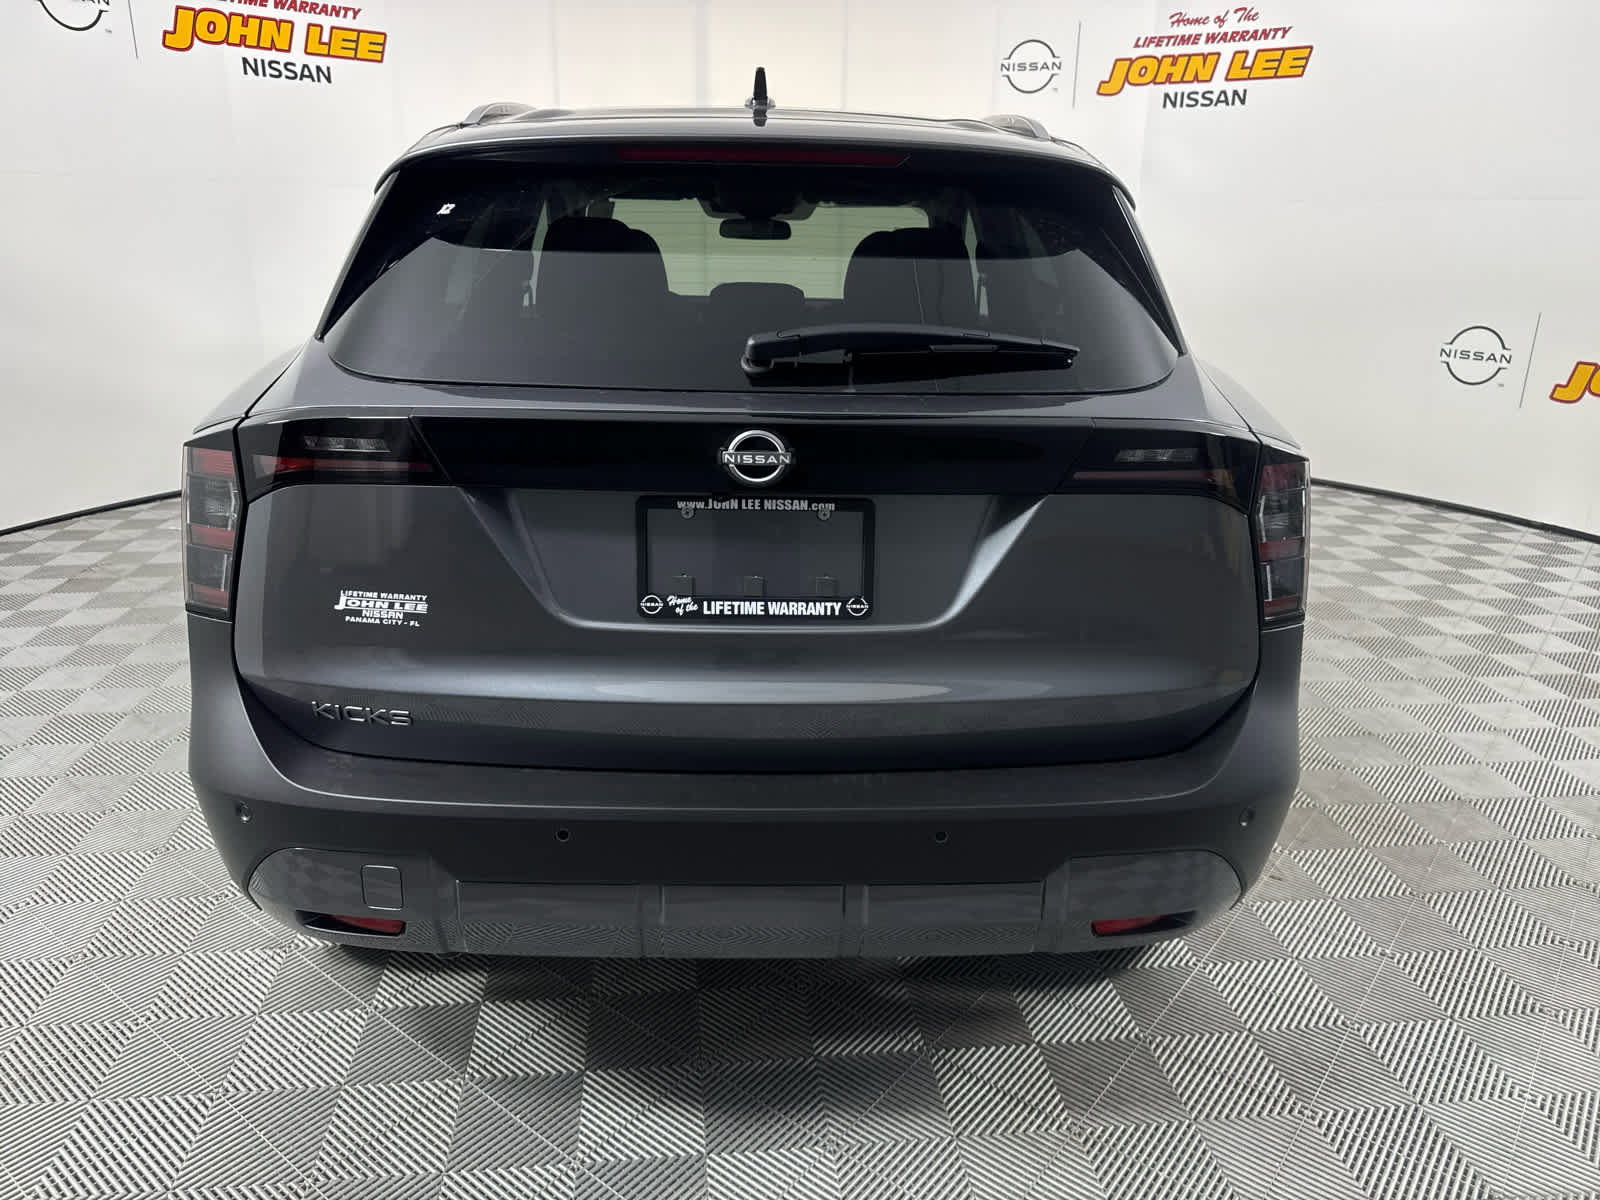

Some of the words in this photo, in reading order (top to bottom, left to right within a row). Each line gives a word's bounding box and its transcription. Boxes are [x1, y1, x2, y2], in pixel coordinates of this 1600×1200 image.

[273, 0, 361, 20] WARRANTY
[1169, 12, 1210, 28] Home
[1213, 10, 1229, 28] of
[1233, 7, 1259, 23] The
[163, 5, 294, 52] JOHN
[304, 24, 387, 62] LEE
[1133, 33, 1202, 48] LIFETIME
[1204, 26, 1293, 44] WARRANTY
[241, 57, 333, 84] NISSAN
[1000, 61, 1062, 72] NISSAN
[1097, 52, 1221, 96] JOHN
[1225, 46, 1313, 81] LEE
[1162, 89, 1247, 109] NISSAN
[1439, 348, 1512, 364] NISSAN
[724, 453, 791, 464] NISSAN
[741, 500, 761, 510] LEE
[341, 590, 378, 599] LIFETIME
[380, 593, 428, 601] WARRANTY
[333, 596, 389, 610] JOHN
[394, 602, 428, 612] LEE
[703, 601, 765, 615] LIFETIME
[768, 601, 842, 616] WARRANTY
[345, 616, 380, 624] PANAMA
[382, 618, 403, 626] CITY
[362, 609, 404, 619] NISSAN
[311, 701, 413, 726] KICKS
